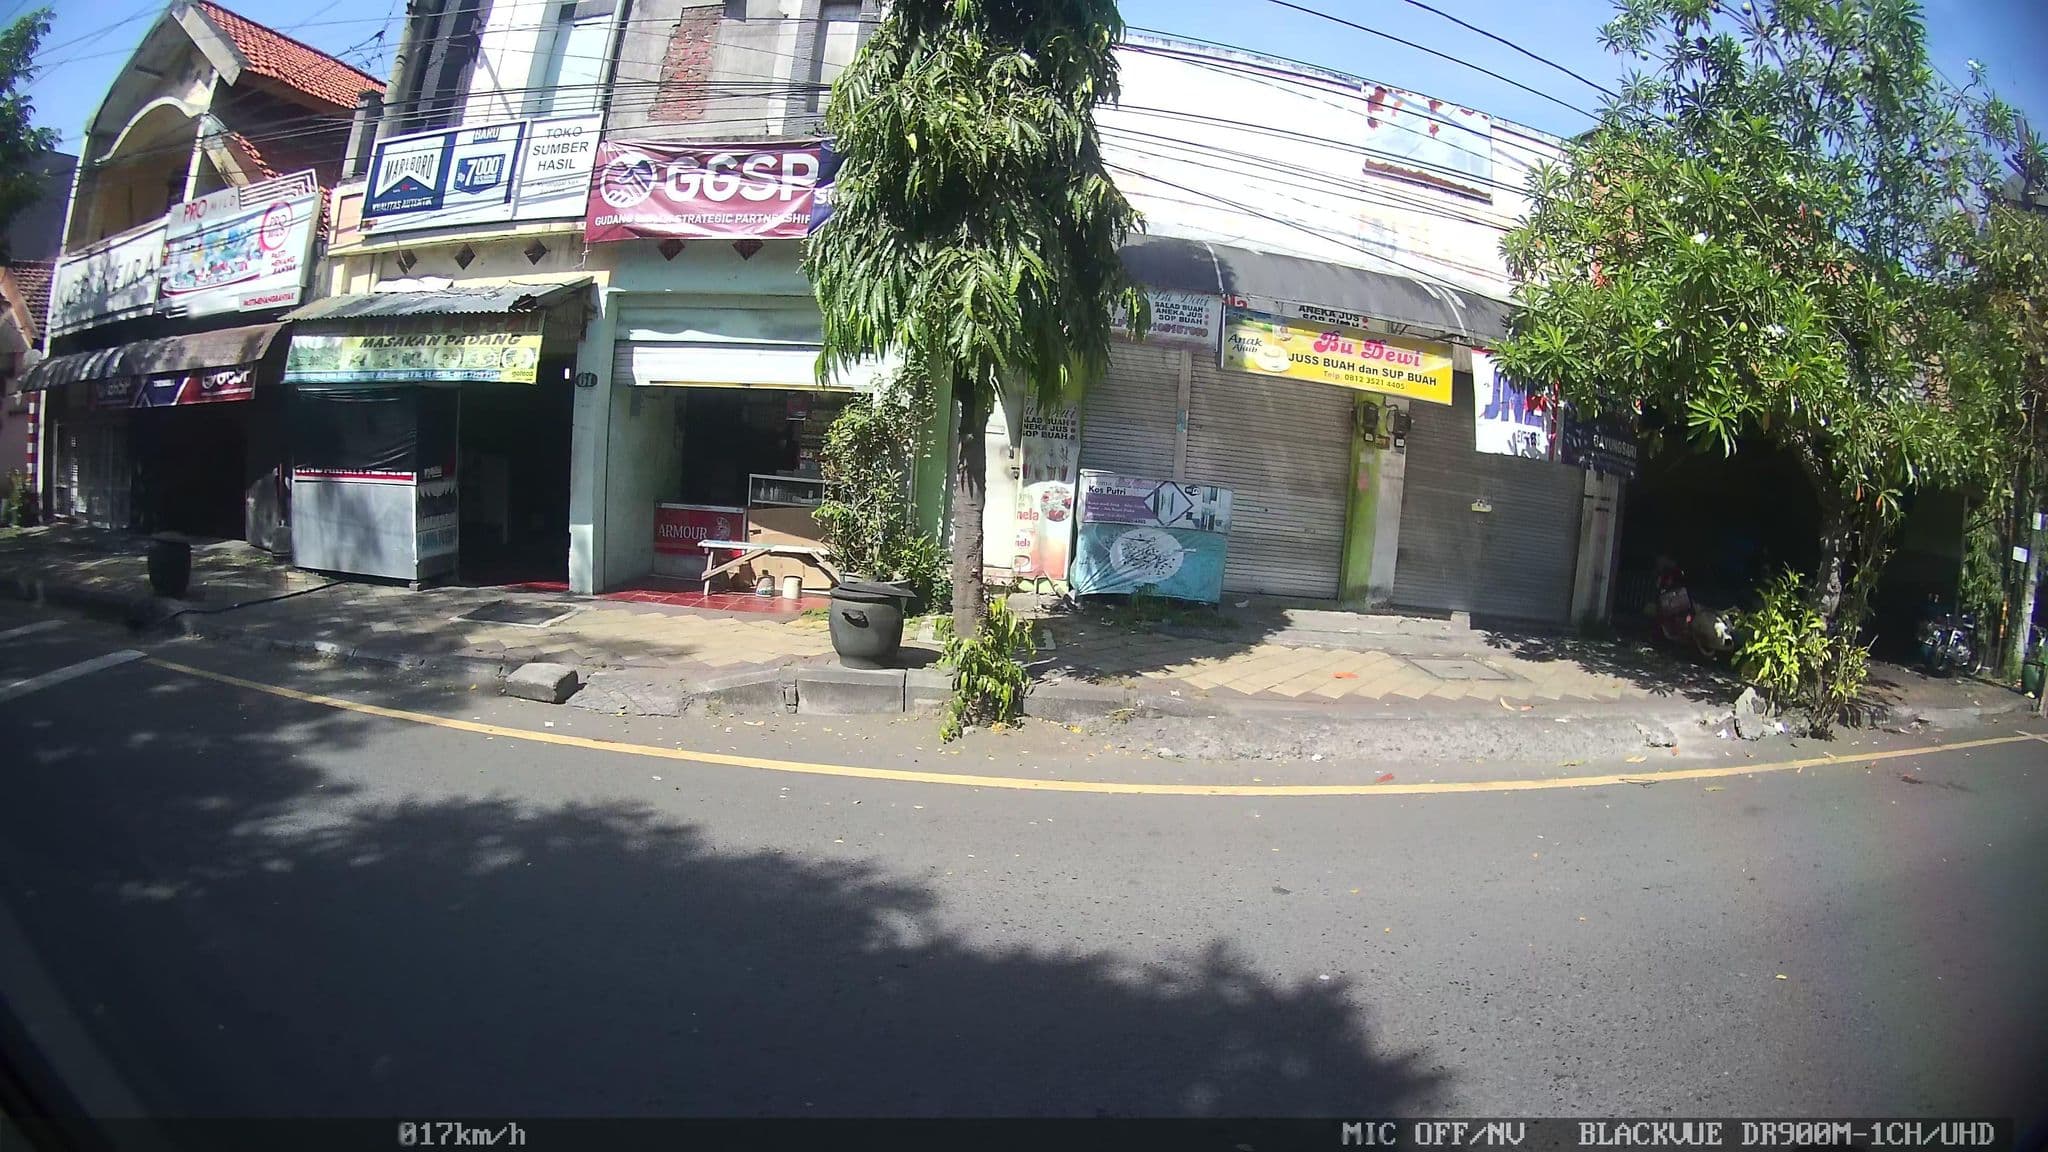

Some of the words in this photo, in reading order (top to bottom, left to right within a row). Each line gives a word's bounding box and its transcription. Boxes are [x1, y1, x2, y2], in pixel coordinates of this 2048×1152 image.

[474, 127, 500, 140] BARU
[545, 127, 583, 139] TOKO
[532, 141, 589, 156] SUMBER
[383, 153, 434, 188] MARLBORO
[464, 156, 500, 187] 7000
[537, 159, 576, 171] HASIL
[664, 152, 820, 203] GGSP
[184, 199, 207, 223] PRO
[677, 214, 734, 225] STRATEGIC
[735, 213, 811, 225] PARTNSHIP
[1155, 301, 1180, 310] SALAD
[1182, 305, 1203, 313] BUAH
[1156, 307, 1185, 317] ANEKA
[1298, 305, 1337, 319] ANEKA
[1338, 310, 1360, 322] JUS
[1158, 314, 1177, 322] SOP
[1179, 317, 1203, 325] BUAH
[360, 334, 440, 348] MASAKAN
[444, 333, 521, 346] PADANG
[1228, 333, 1263, 347] Anak
[1313, 330, 1353, 355] Bu
[1361, 338, 1421, 367] Dewi
[1288, 352, 1319, 366] JUSS
[1323, 358, 1356, 372] BUAH
[1358, 364, 1379, 376] dan
[1382, 368, 1405, 380] SUP
[1407, 373, 1437, 387] BUAH
[1344, 374, 1364, 383] 0812
[1048, 418, 1069, 426] UAH
[1088, 485, 1104, 494] Kos
[1106, 487, 1126, 496] Putri
[658, 524, 708, 539] ARMOUR
